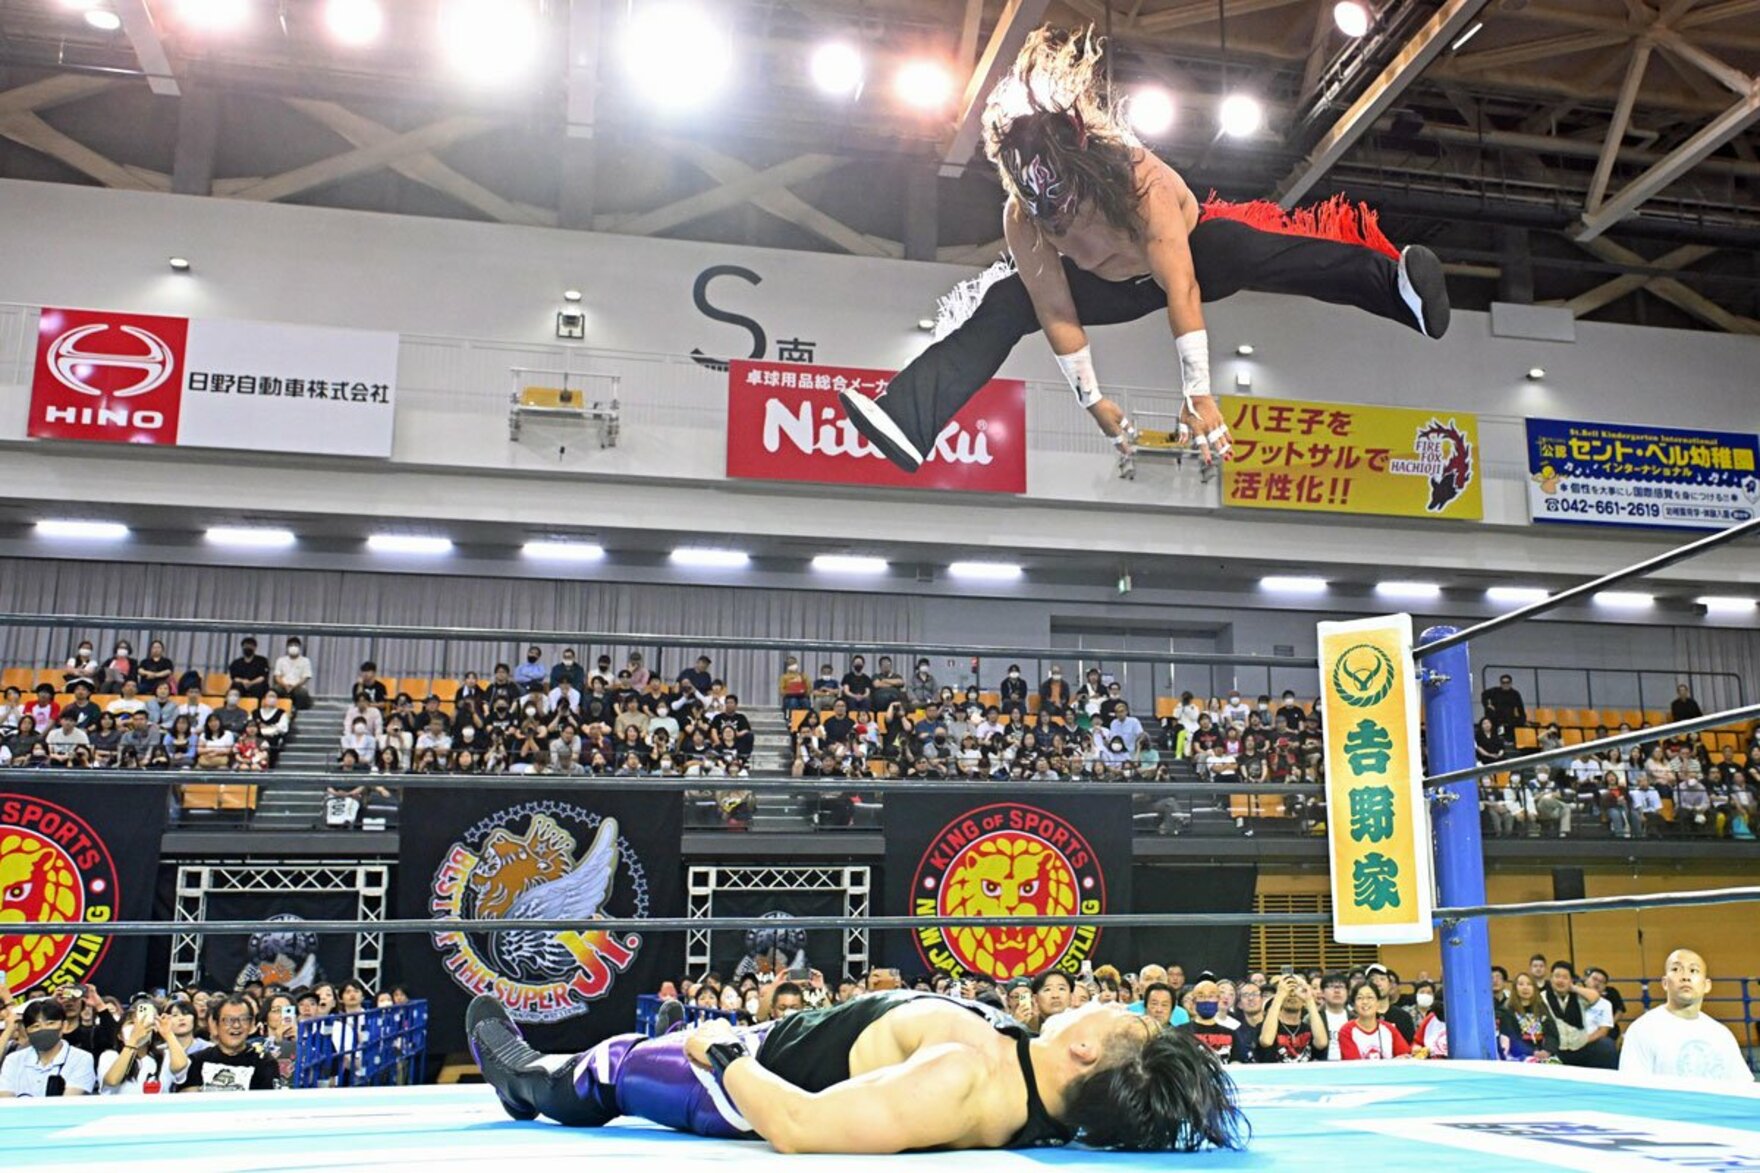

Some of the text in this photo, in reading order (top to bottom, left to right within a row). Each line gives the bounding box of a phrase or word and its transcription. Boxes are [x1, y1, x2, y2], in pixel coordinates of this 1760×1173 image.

[188, 371, 391, 405] 日野自動車株式会社
[45, 405, 164, 430] HINO
[762, 397, 993, 466] Nitku
[1232, 403, 1353, 436] 八王子を
[1416, 440, 1441, 452] FIRE
[1568, 437, 1755, 471] セント・ベル幼稚園
[1601, 431, 1659, 442] Kindergarten
[1661, 434, 1718, 446] International
[1232, 439, 1389, 473] フットサルで
[1391, 461, 1441, 475] HACHIOJI
[1421, 451, 1441, 463] FOX
[1602, 463, 1693, 478] インターナショナル
[1561, 498, 1660, 518] 042-661-2619
[1, 800, 102, 870] SPORTS
[929, 809, 1090, 872] KING OF SPORTS
[432, 846, 478, 919] BEST
[446, 944, 499, 996] THE
[493, 977, 573, 1010] SUPER
